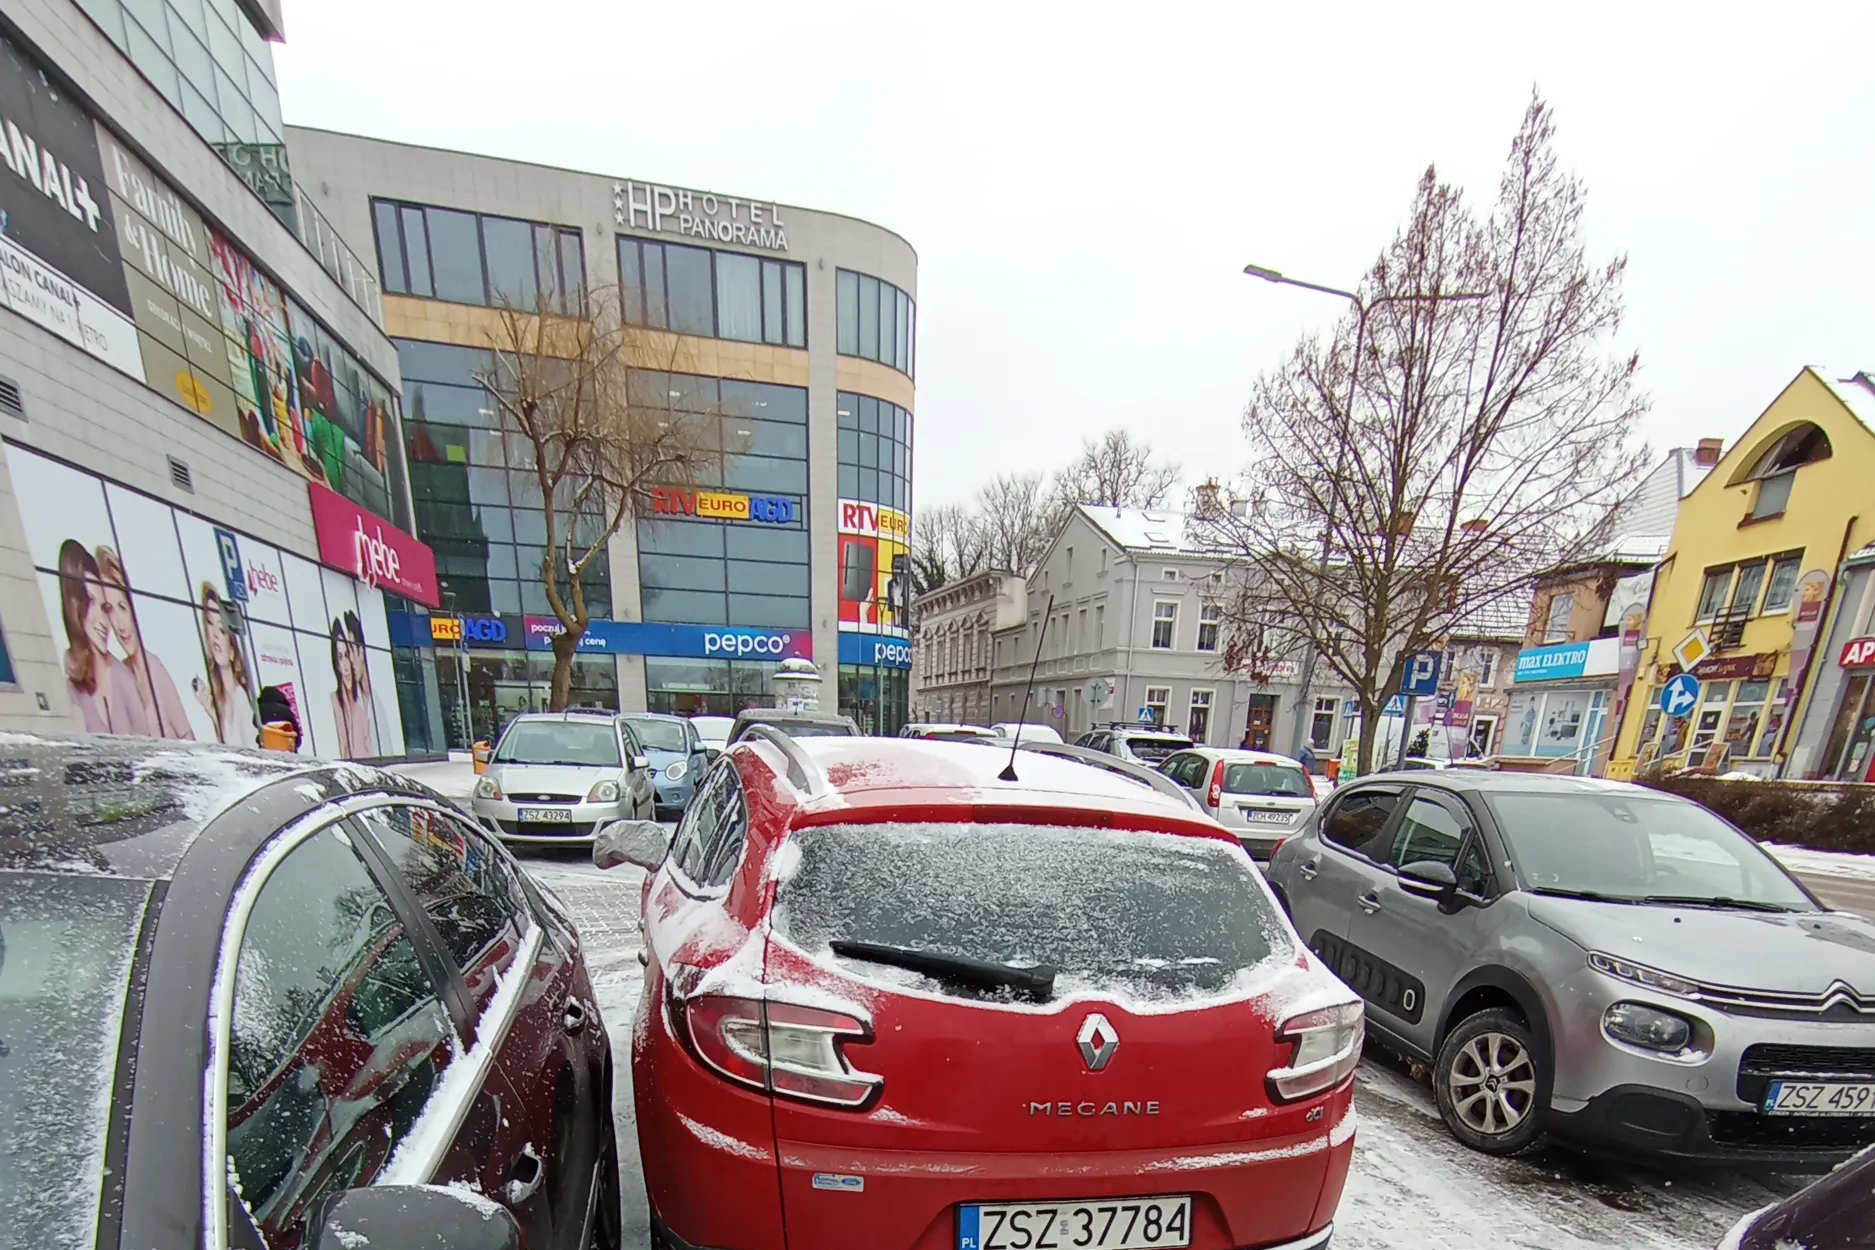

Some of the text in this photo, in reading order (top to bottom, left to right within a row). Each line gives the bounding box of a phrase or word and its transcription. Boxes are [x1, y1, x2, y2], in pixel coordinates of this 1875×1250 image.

[112, 144, 196, 270] Family
[628, 181, 676, 232] HP
[679, 190, 784, 227] HOTEL
[679, 213, 788, 250] PANORAMA
[138, 223, 213, 319] Home
[652, 487, 794, 523] RTV EURO AGD
[843, 502, 878, 532] RTV
[219, 534, 238, 580] P
[355, 514, 401, 590] hebe
[248, 559, 278, 596] hebe
[465, 618, 507, 642] AGD
[875, 642, 912, 665] pepc
[1409, 654, 1434, 689] P
[1519, 650, 1586, 669] max ELEKTRO
[524, 810, 570, 821] ZSZ 43294
[1030, 1101, 1161, 1116] MEGANE
[1777, 1085, 1826, 1109] ZSZ
[961, 1238, 977, 1249] PL
[983, 1202, 1187, 1250] ZSZ 37784
